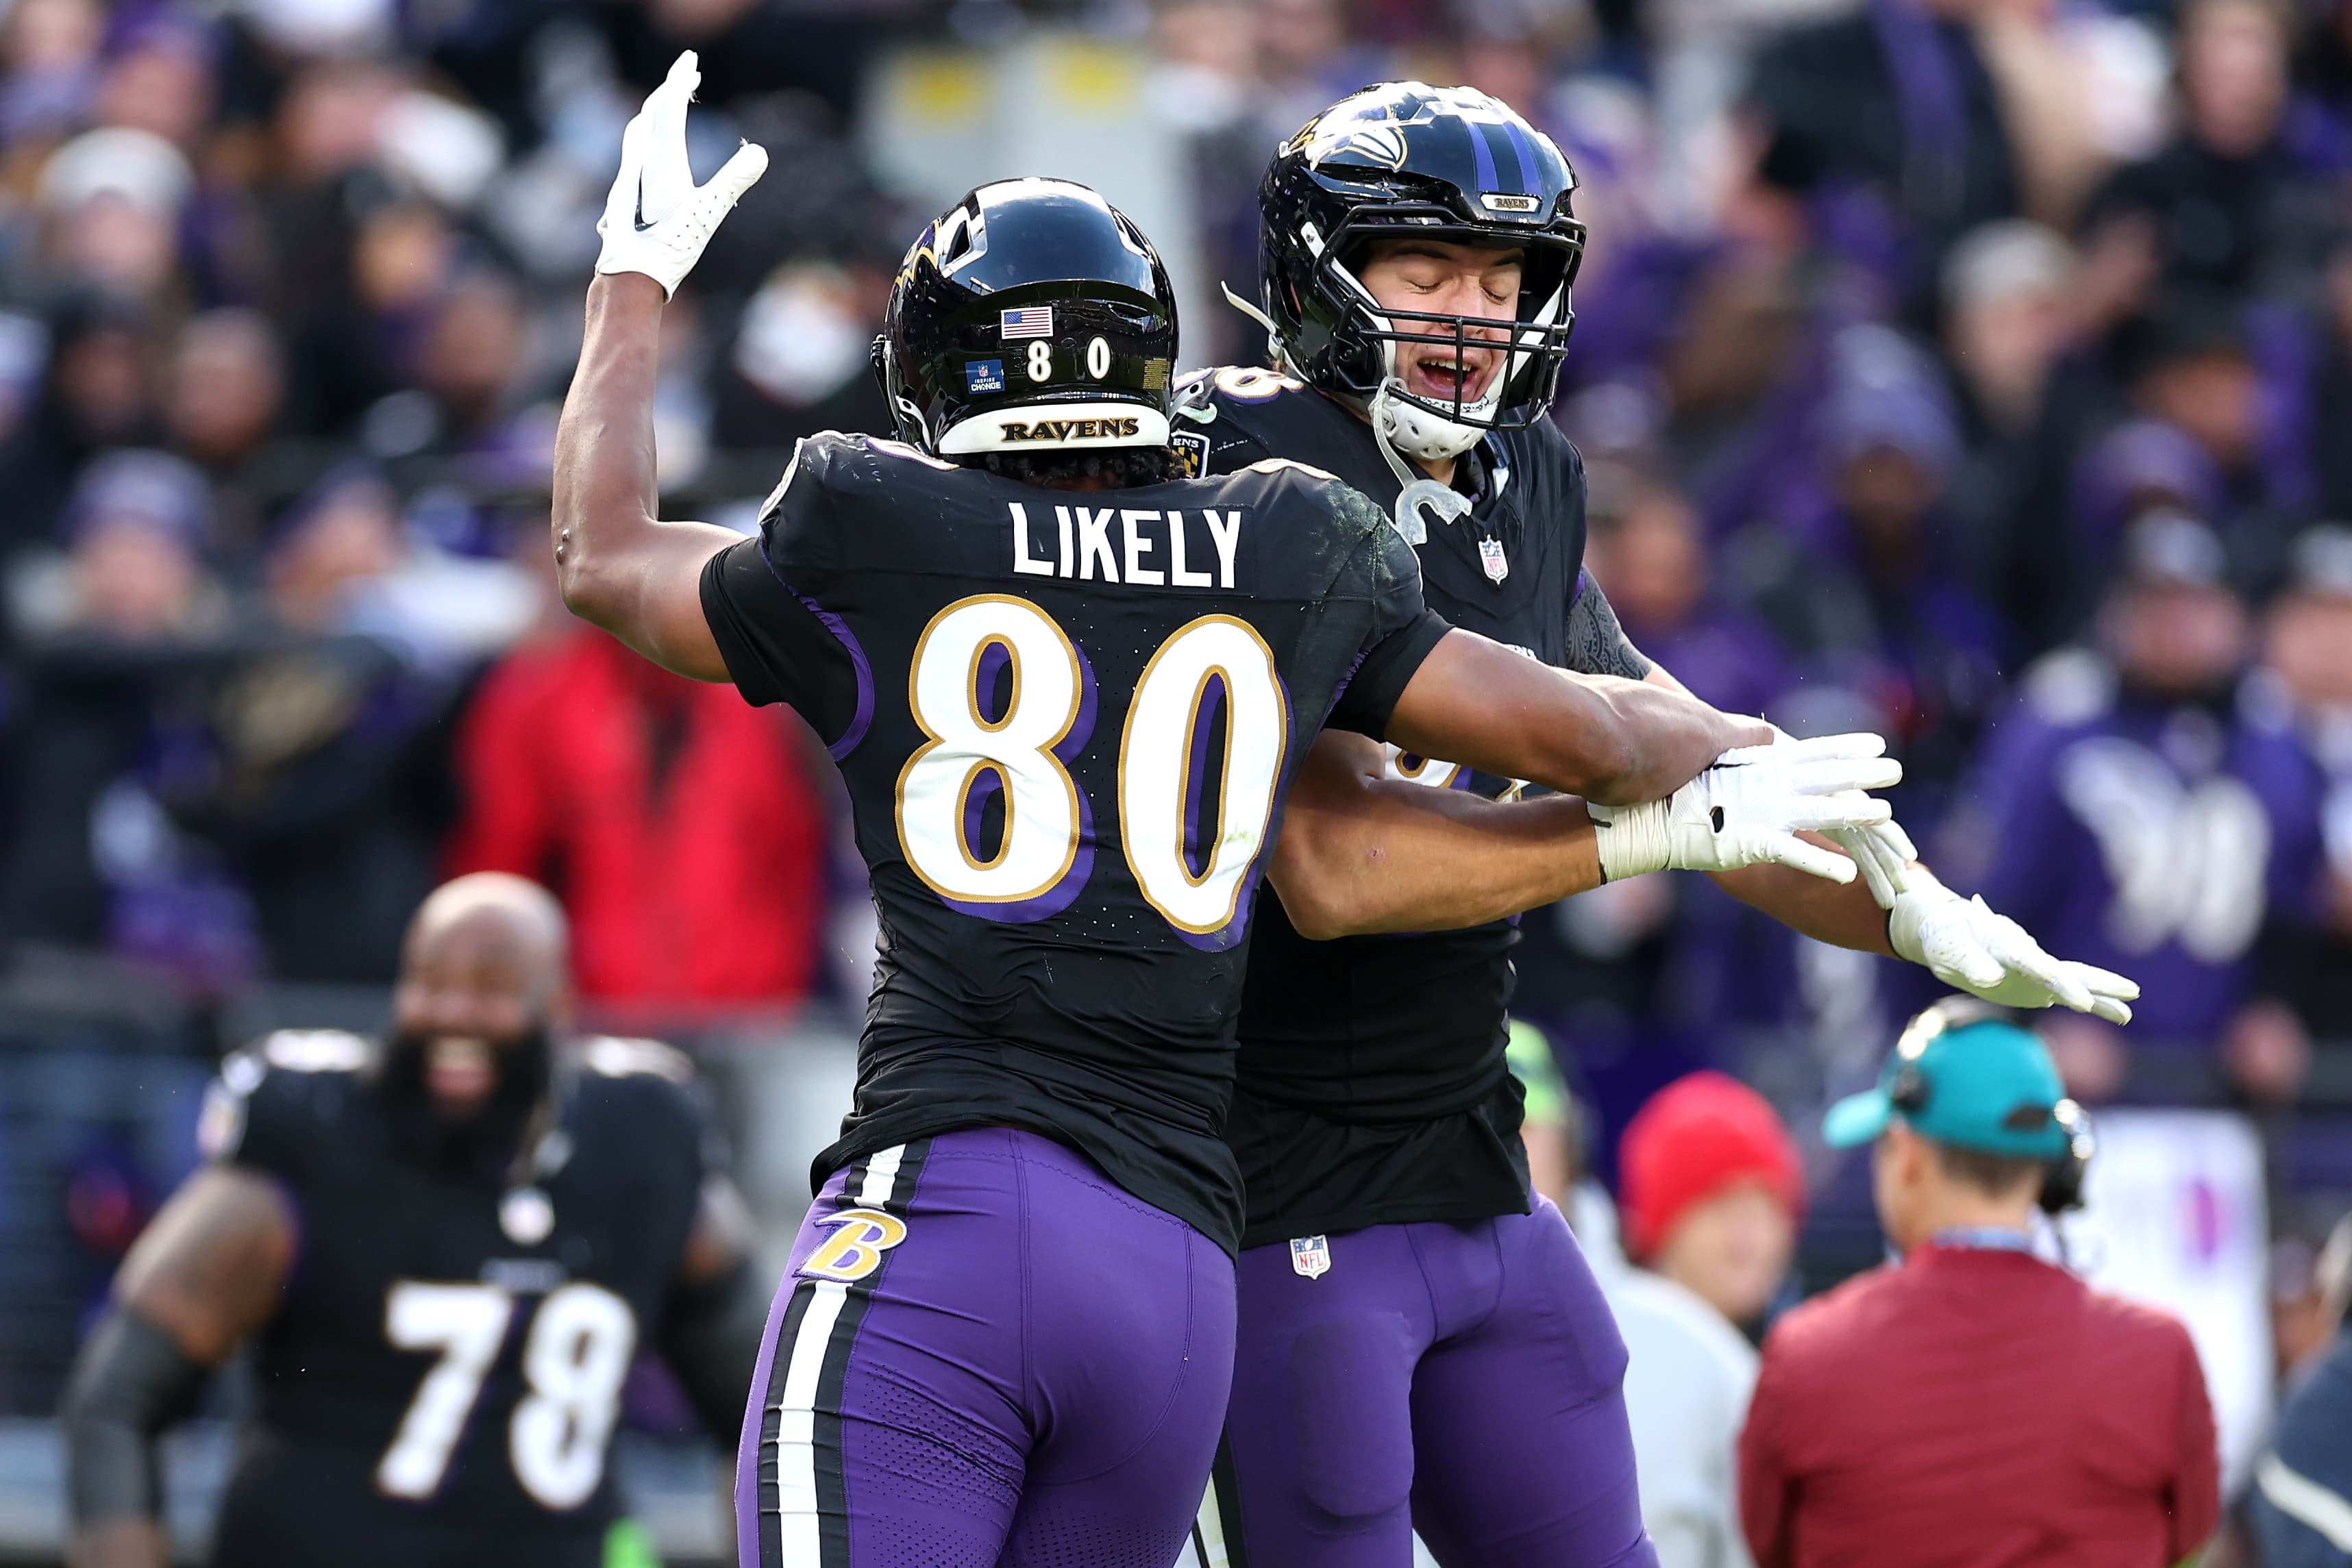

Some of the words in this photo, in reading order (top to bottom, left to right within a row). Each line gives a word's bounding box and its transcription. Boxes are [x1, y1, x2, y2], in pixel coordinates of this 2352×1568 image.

[1494, 198, 1529, 209] RAVENS
[971, 382, 1002, 391] CHANGE
[999, 417, 1139, 443] RAVENS
[1172, 438, 1200, 448] ENS
[1008, 502, 1241, 588] LIKELY
[1487, 558, 1505, 574] NFL
[895, 593, 1291, 942] 80
[1298, 1252, 1324, 1269] NFL
[375, 1278, 637, 1510] 78
